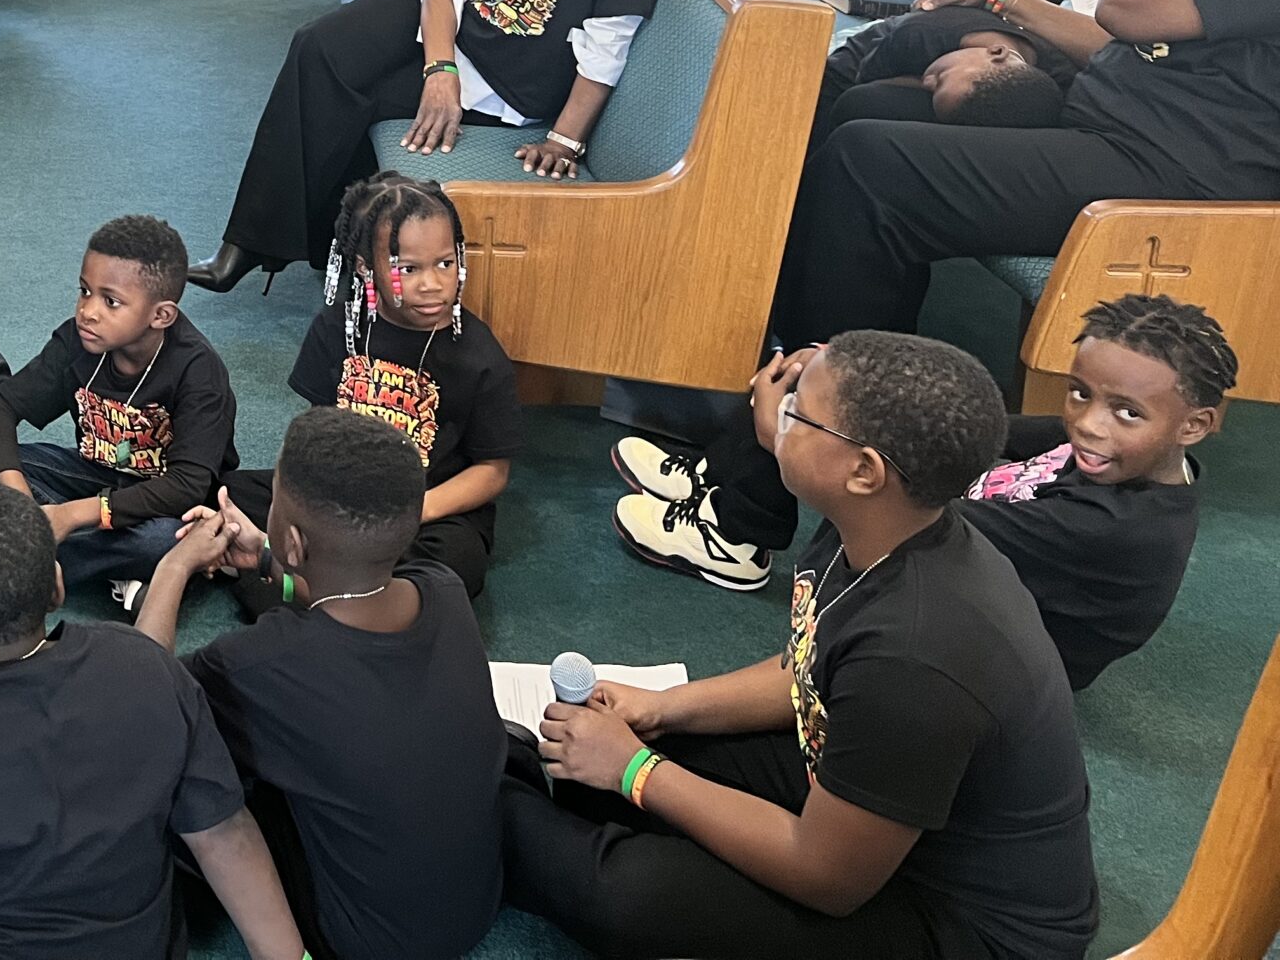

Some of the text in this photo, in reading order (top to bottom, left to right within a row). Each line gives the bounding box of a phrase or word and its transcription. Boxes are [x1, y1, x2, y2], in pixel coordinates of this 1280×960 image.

[373, 369, 404, 389] I AM
[353, 381, 420, 418] BLACK
[111, 408, 131, 430] AM
